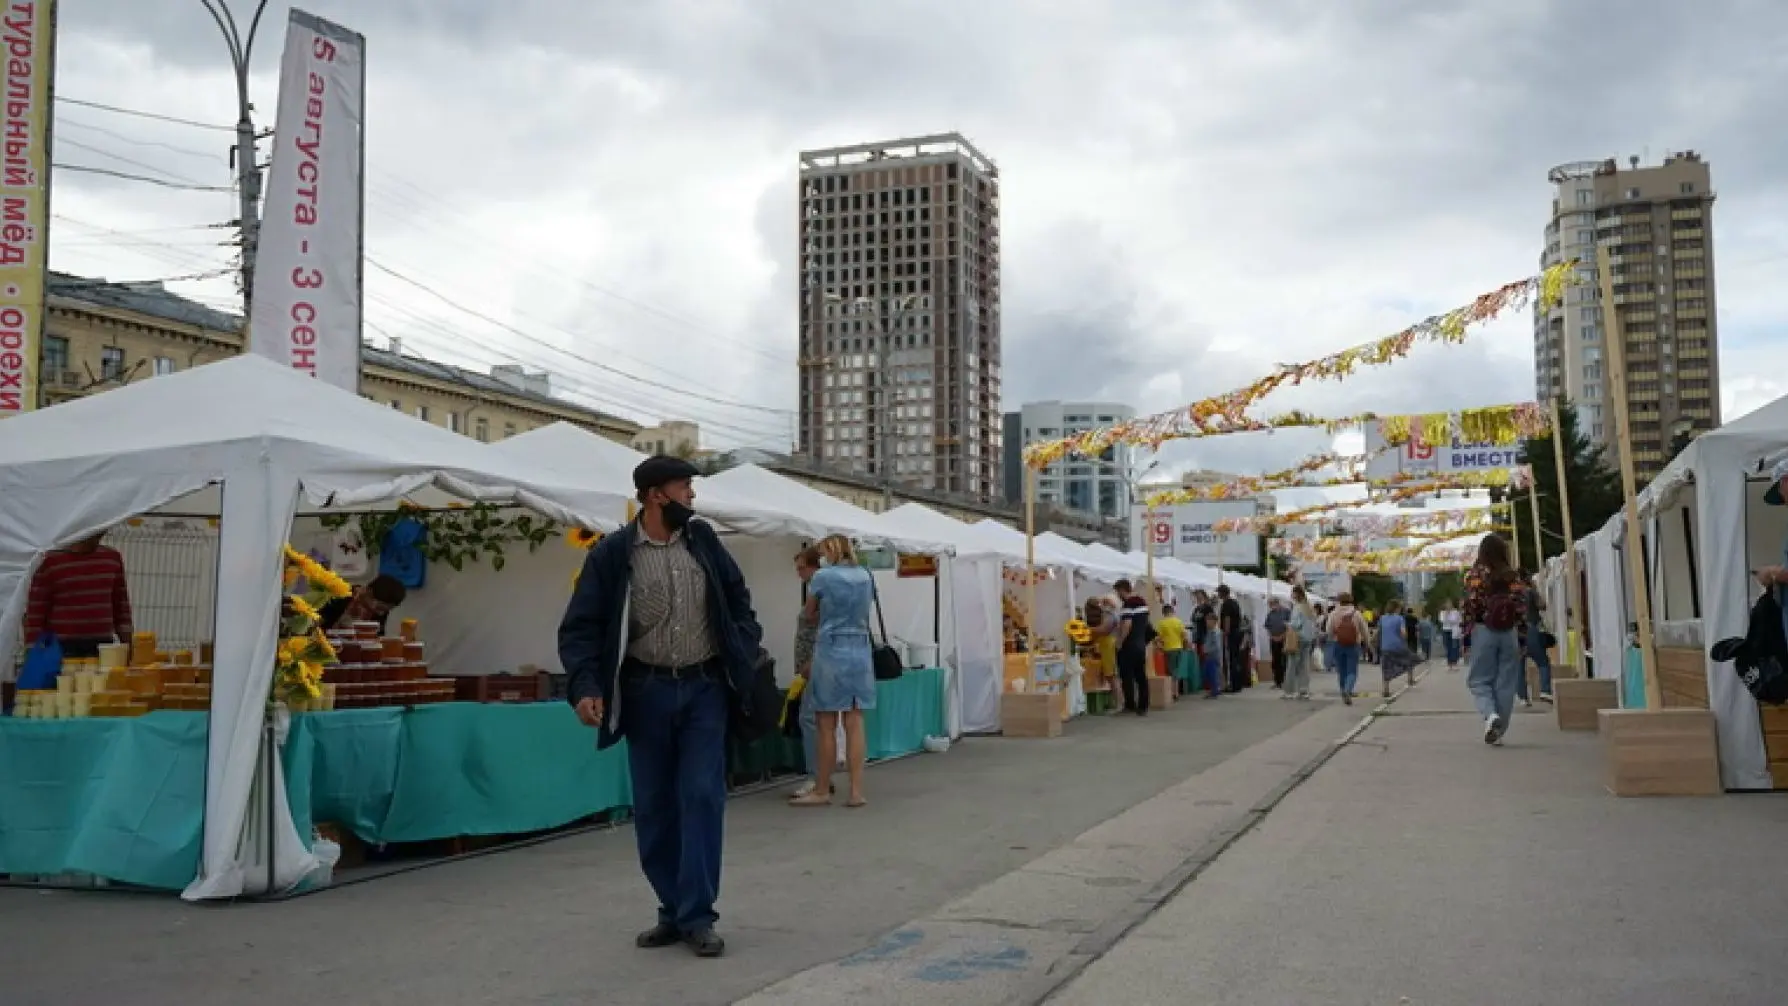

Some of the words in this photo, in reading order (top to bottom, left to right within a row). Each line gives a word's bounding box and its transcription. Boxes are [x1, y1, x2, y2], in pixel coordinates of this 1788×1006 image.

[3, 2, 35, 187] туральный
[295, 71, 326, 226] августа
[0, 198, 33, 266] мёд
[292, 265, 323, 289] 3
[0, 308, 24, 410] орехи
[290, 301, 317, 378] сен
